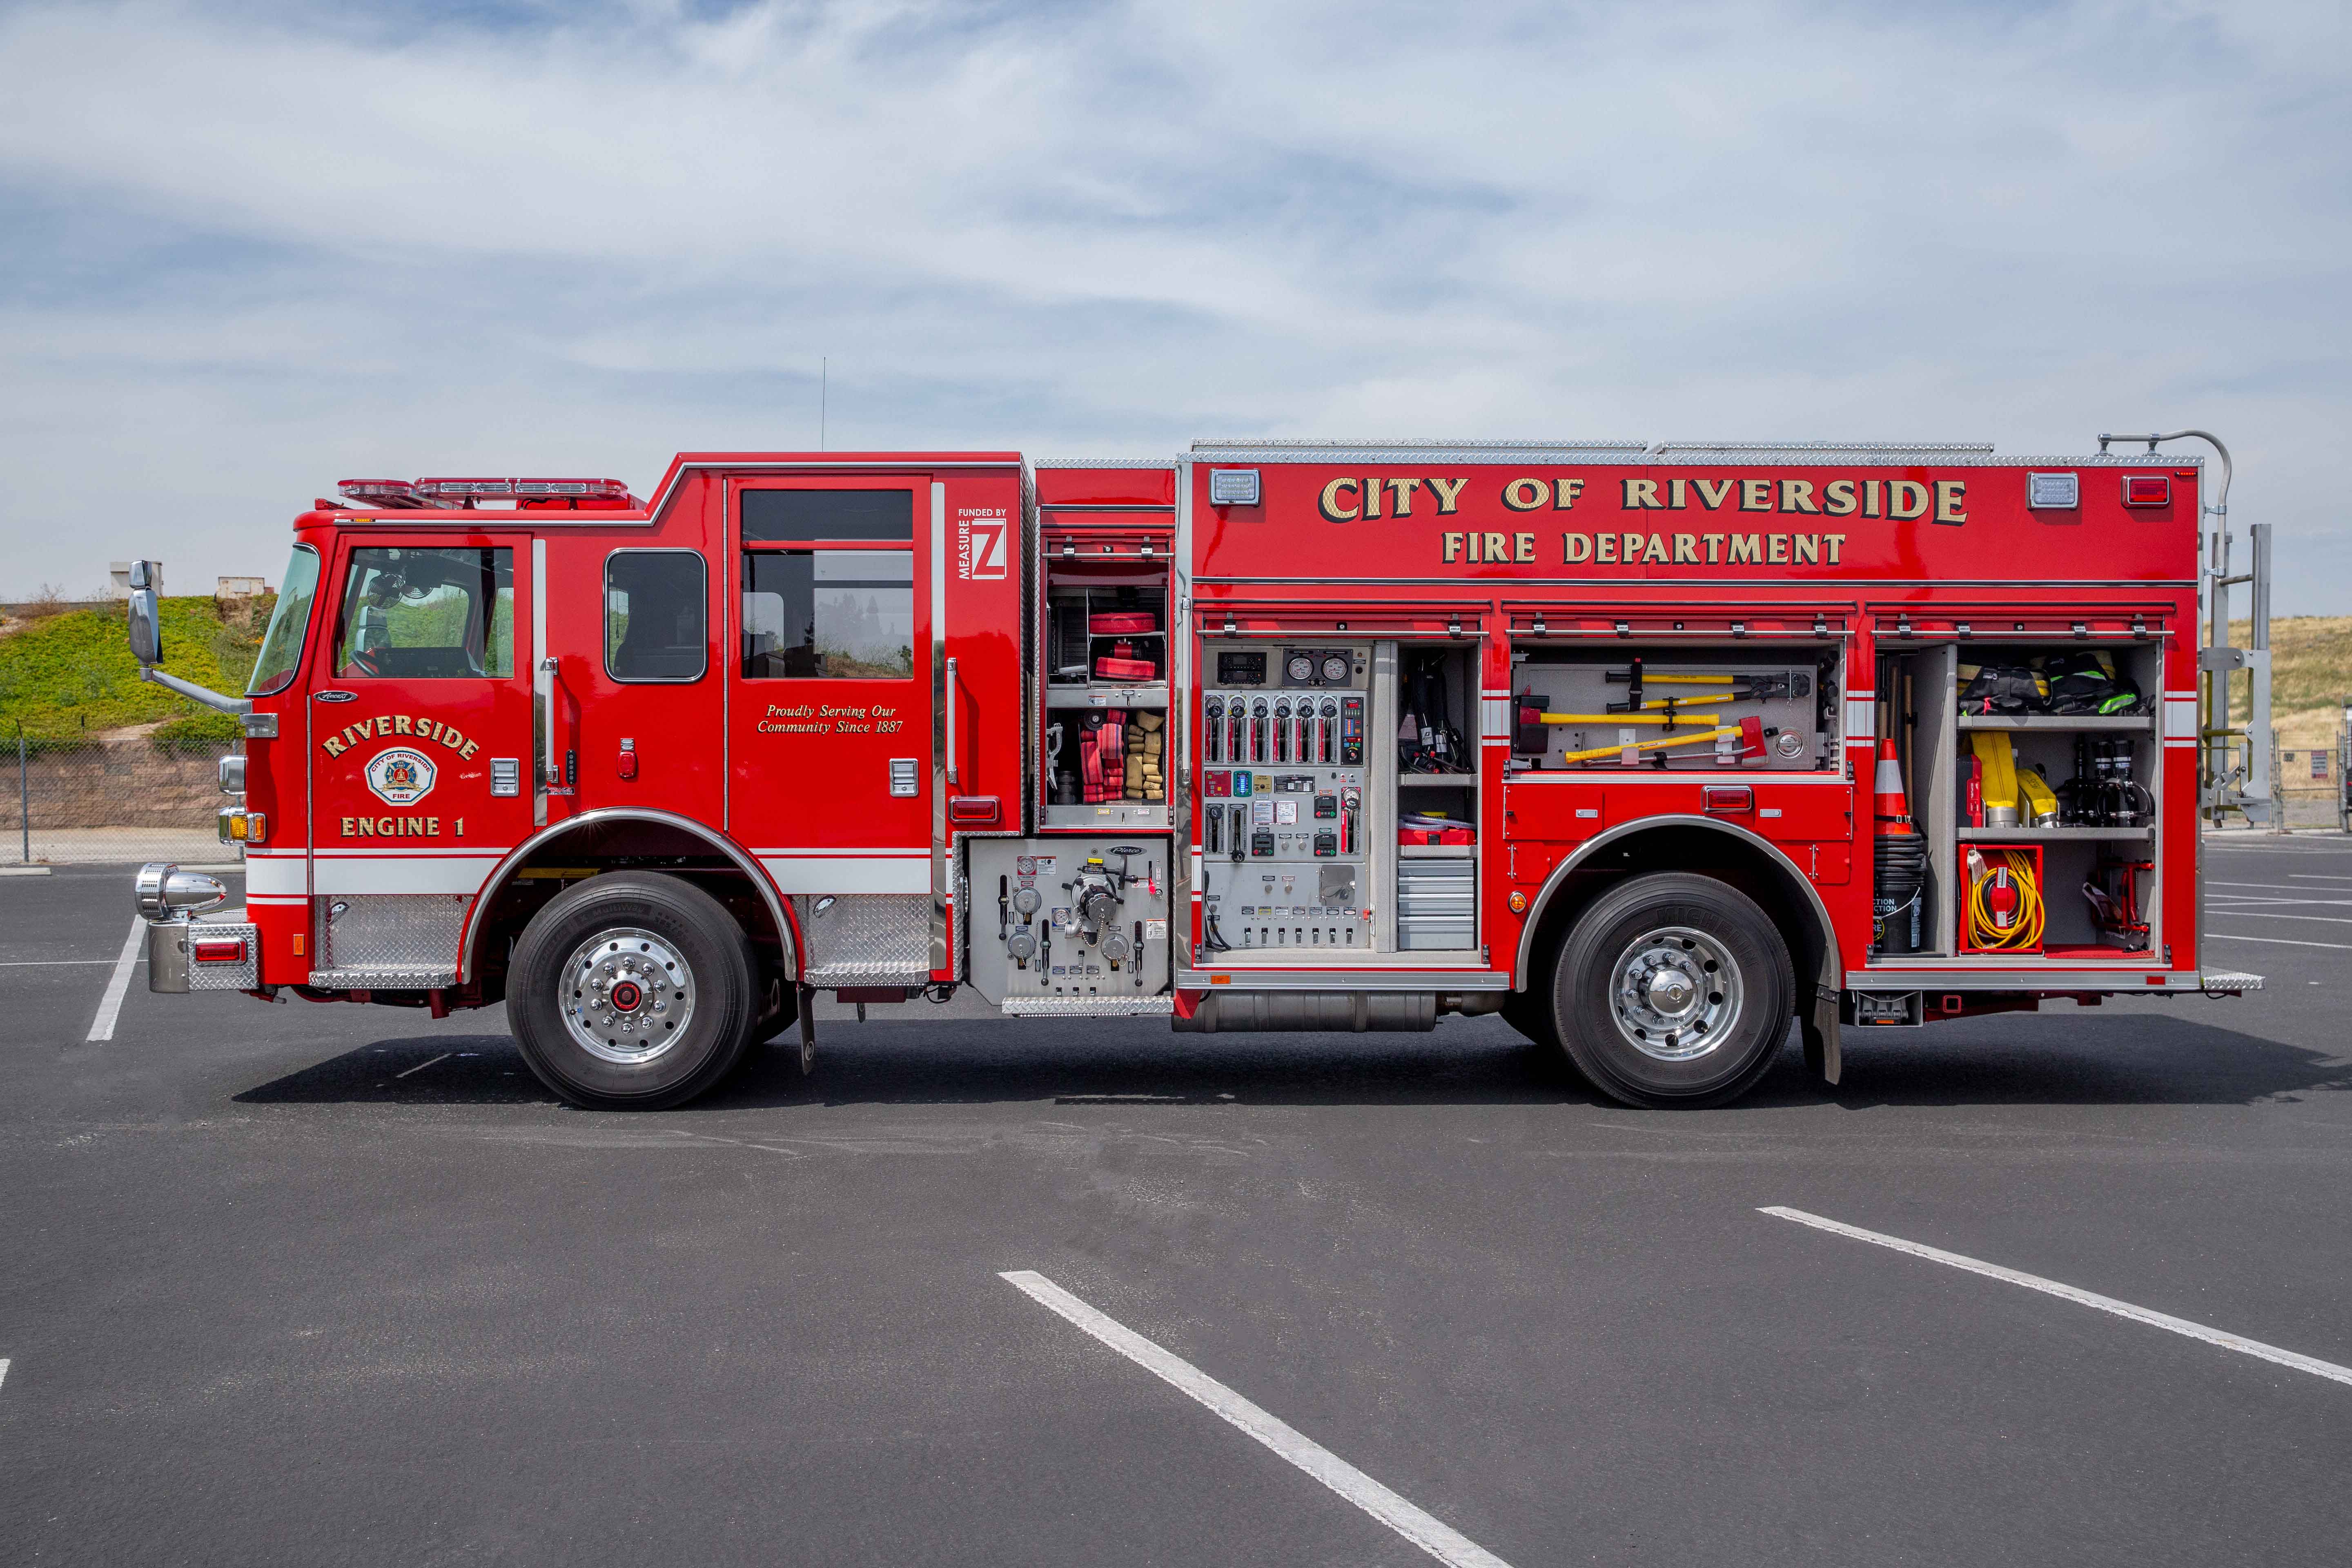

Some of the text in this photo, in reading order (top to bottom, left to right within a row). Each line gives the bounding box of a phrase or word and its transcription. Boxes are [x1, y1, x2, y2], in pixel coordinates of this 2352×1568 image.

[1317, 477, 1968, 527] CITY OF RIVERSIDE
[958, 520, 970, 580] MEASURE
[972, 524, 1005, 576] Z
[1441, 532, 1846, 566] FIRE DEPARTMENT
[757, 721, 903, 735] Community Since 1887
[766, 705, 896, 719] Proudly Serving Our
[322, 715, 479, 761] RIVERSIDE
[372, 758, 385, 772] CITY
[397, 753, 431, 773] RIVERSIDE
[340, 817, 464, 837] ENGINE 1
[1656, 906, 1759, 969] MICHELIN
